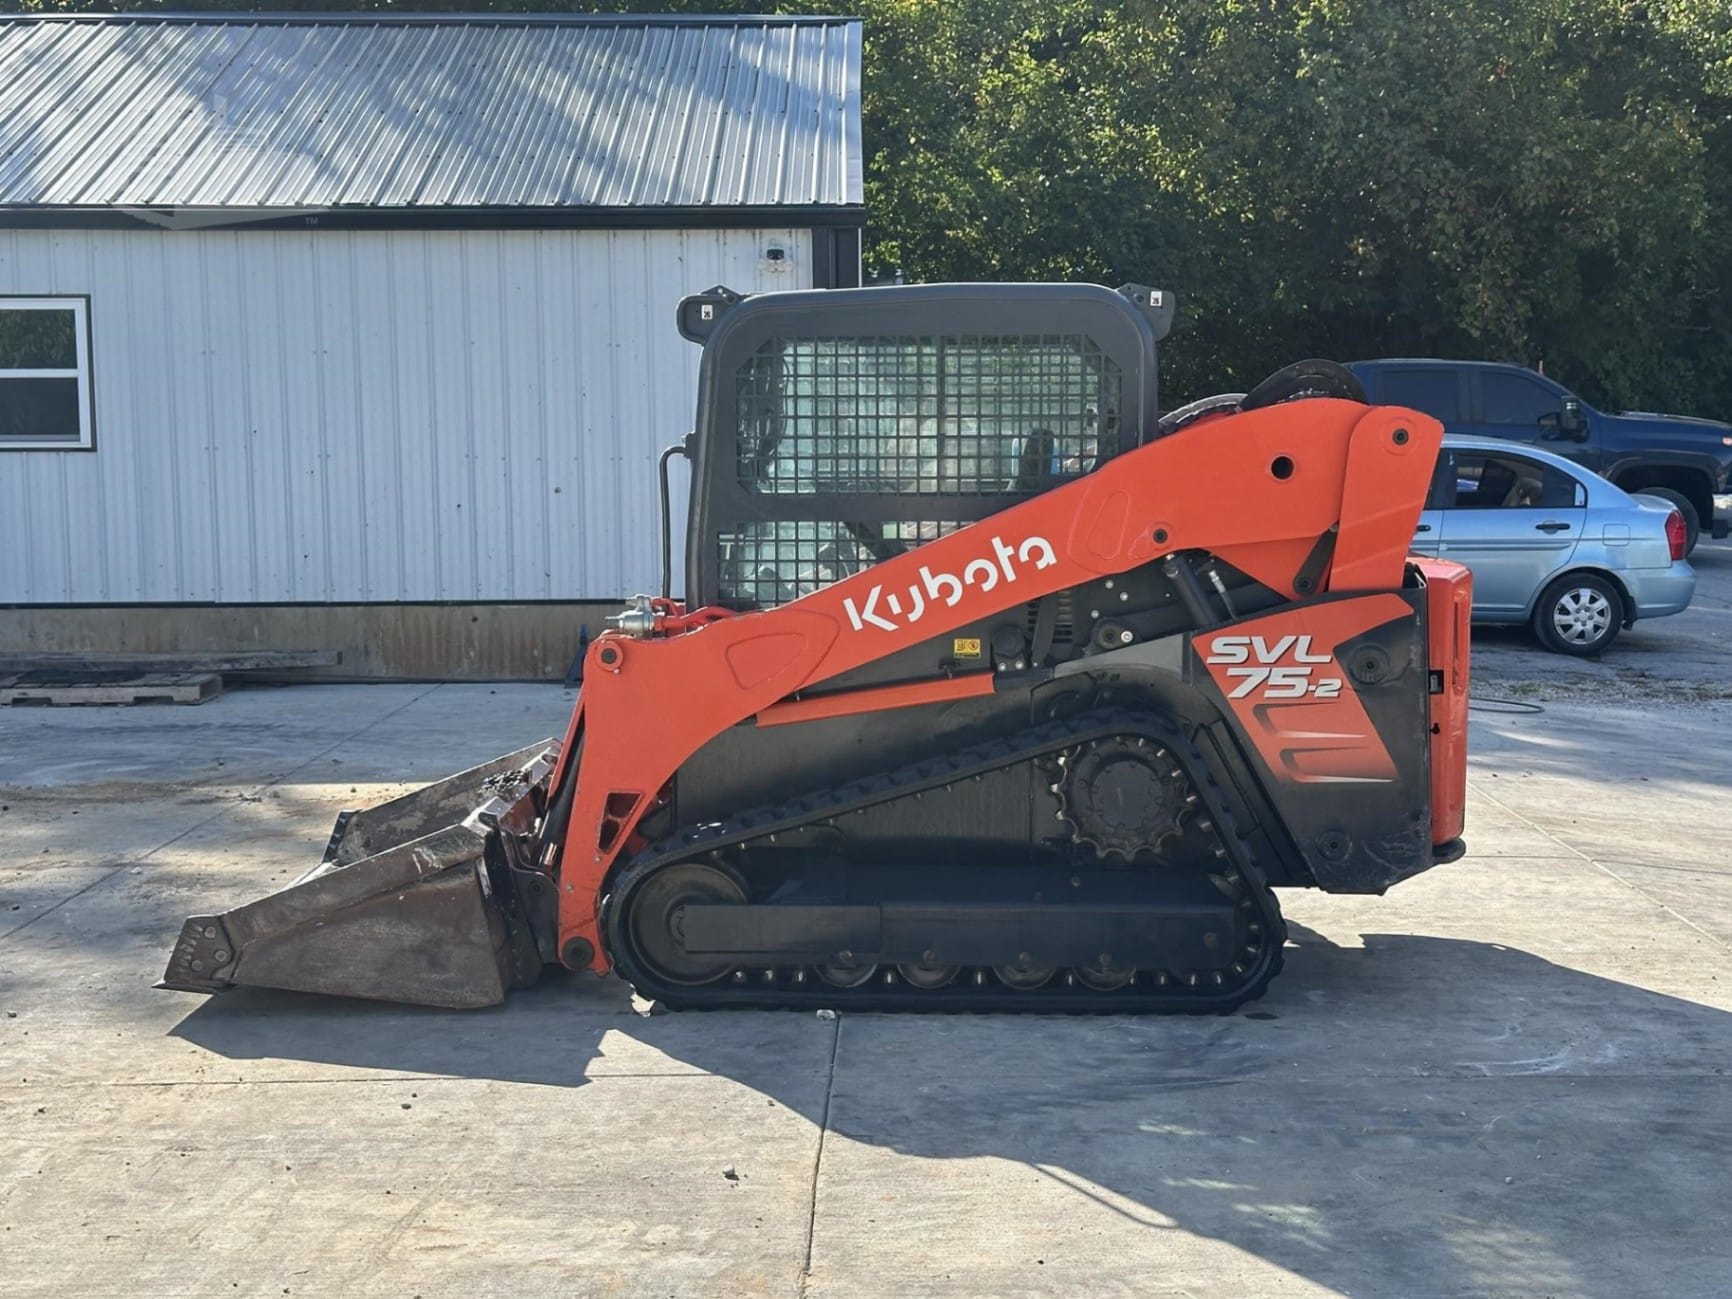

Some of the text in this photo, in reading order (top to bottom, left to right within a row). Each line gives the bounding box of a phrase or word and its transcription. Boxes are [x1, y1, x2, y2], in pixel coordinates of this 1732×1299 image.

[843, 536, 1057, 632] Kubota
[1207, 635, 1332, 664] SVL
[1227, 667, 1342, 698] 75-2
